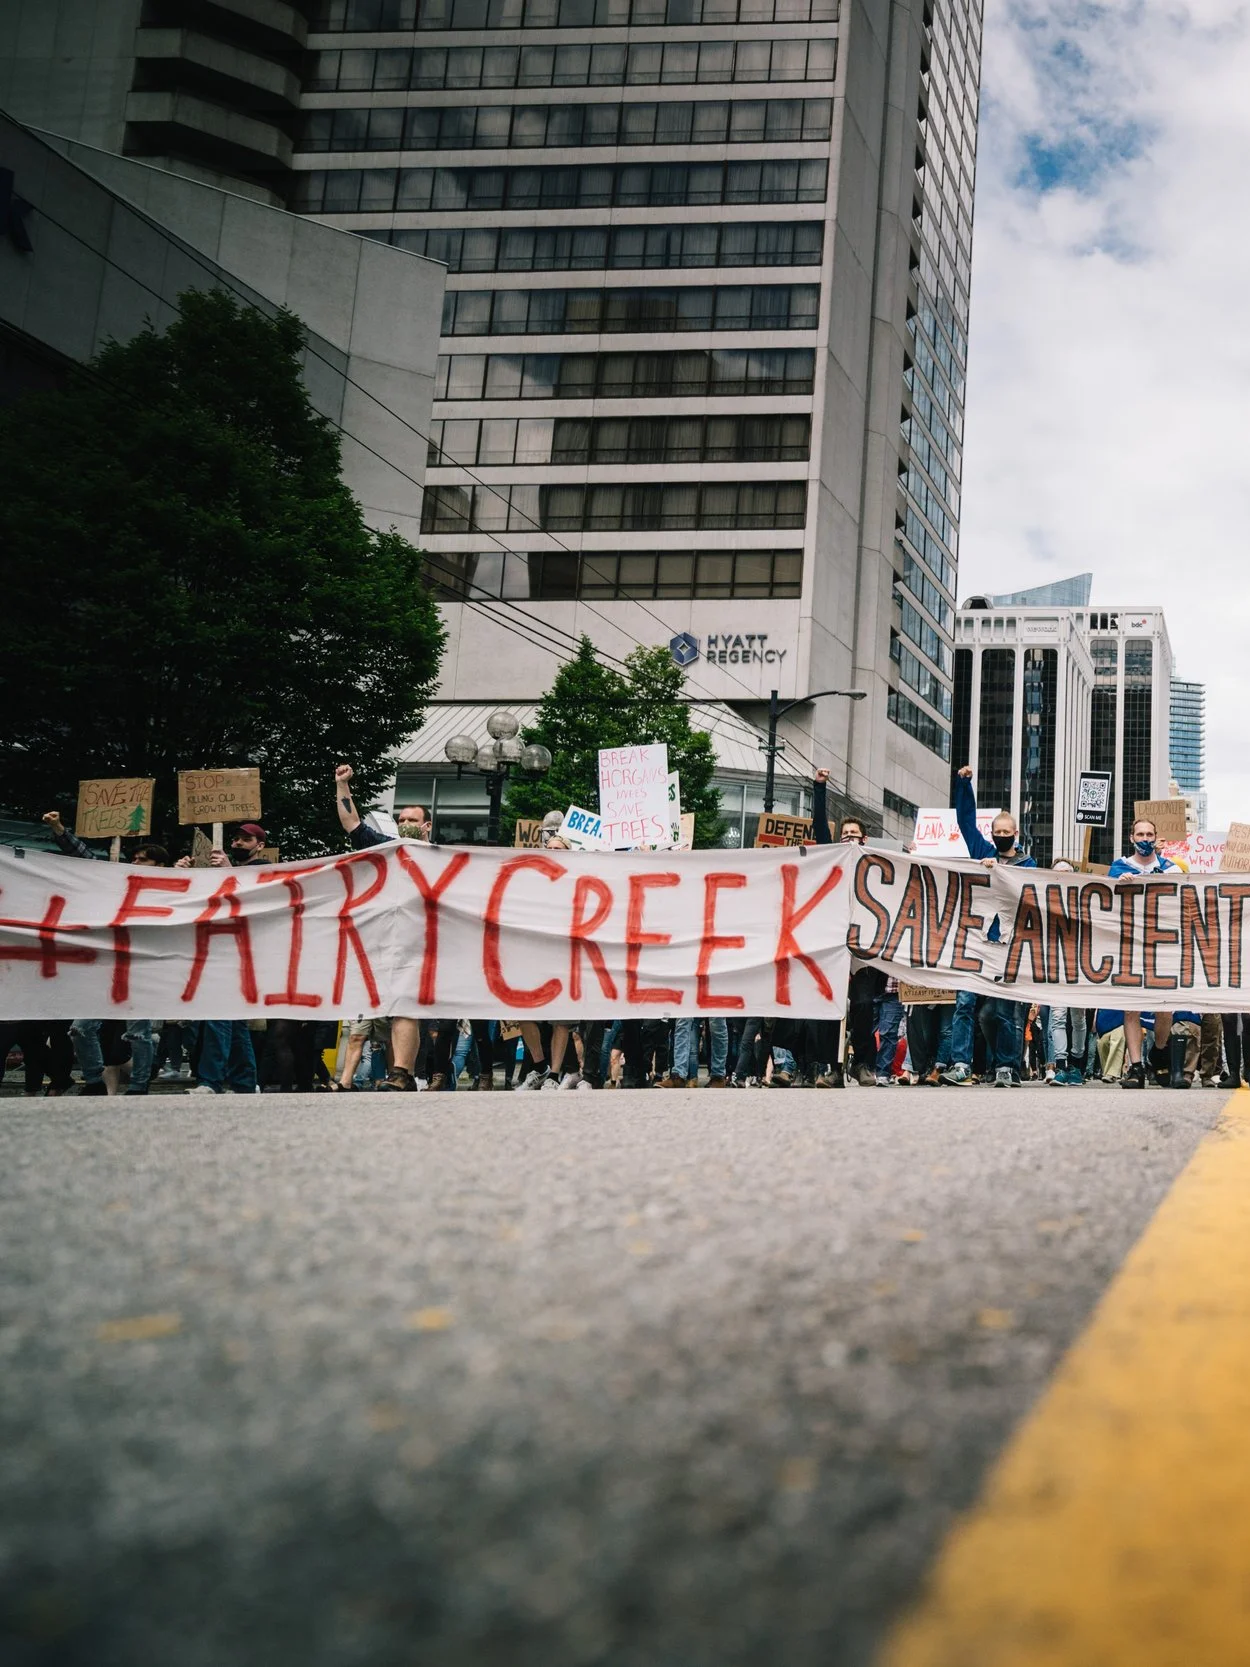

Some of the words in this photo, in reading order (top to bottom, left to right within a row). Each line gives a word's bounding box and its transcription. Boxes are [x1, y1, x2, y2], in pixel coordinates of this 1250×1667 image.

[707, 634, 768, 649] HYATT
[706, 649, 787, 664] REGENCY
[600, 748, 650, 767] BREAK
[185, 775, 225, 791] STOP
[84, 781, 127, 806] SAVE
[130, 781, 150, 802] THE
[218, 793, 236, 802] OLD
[193, 804, 227, 815] GROWTH
[607, 801, 645, 818] SAVE
[567, 810, 602, 839] BREA
[765, 818, 817, 841] DEFEN
[1195, 835, 1226, 853] Save
[1189, 856, 1215, 867] What
[846, 853, 992, 973] SAVE
